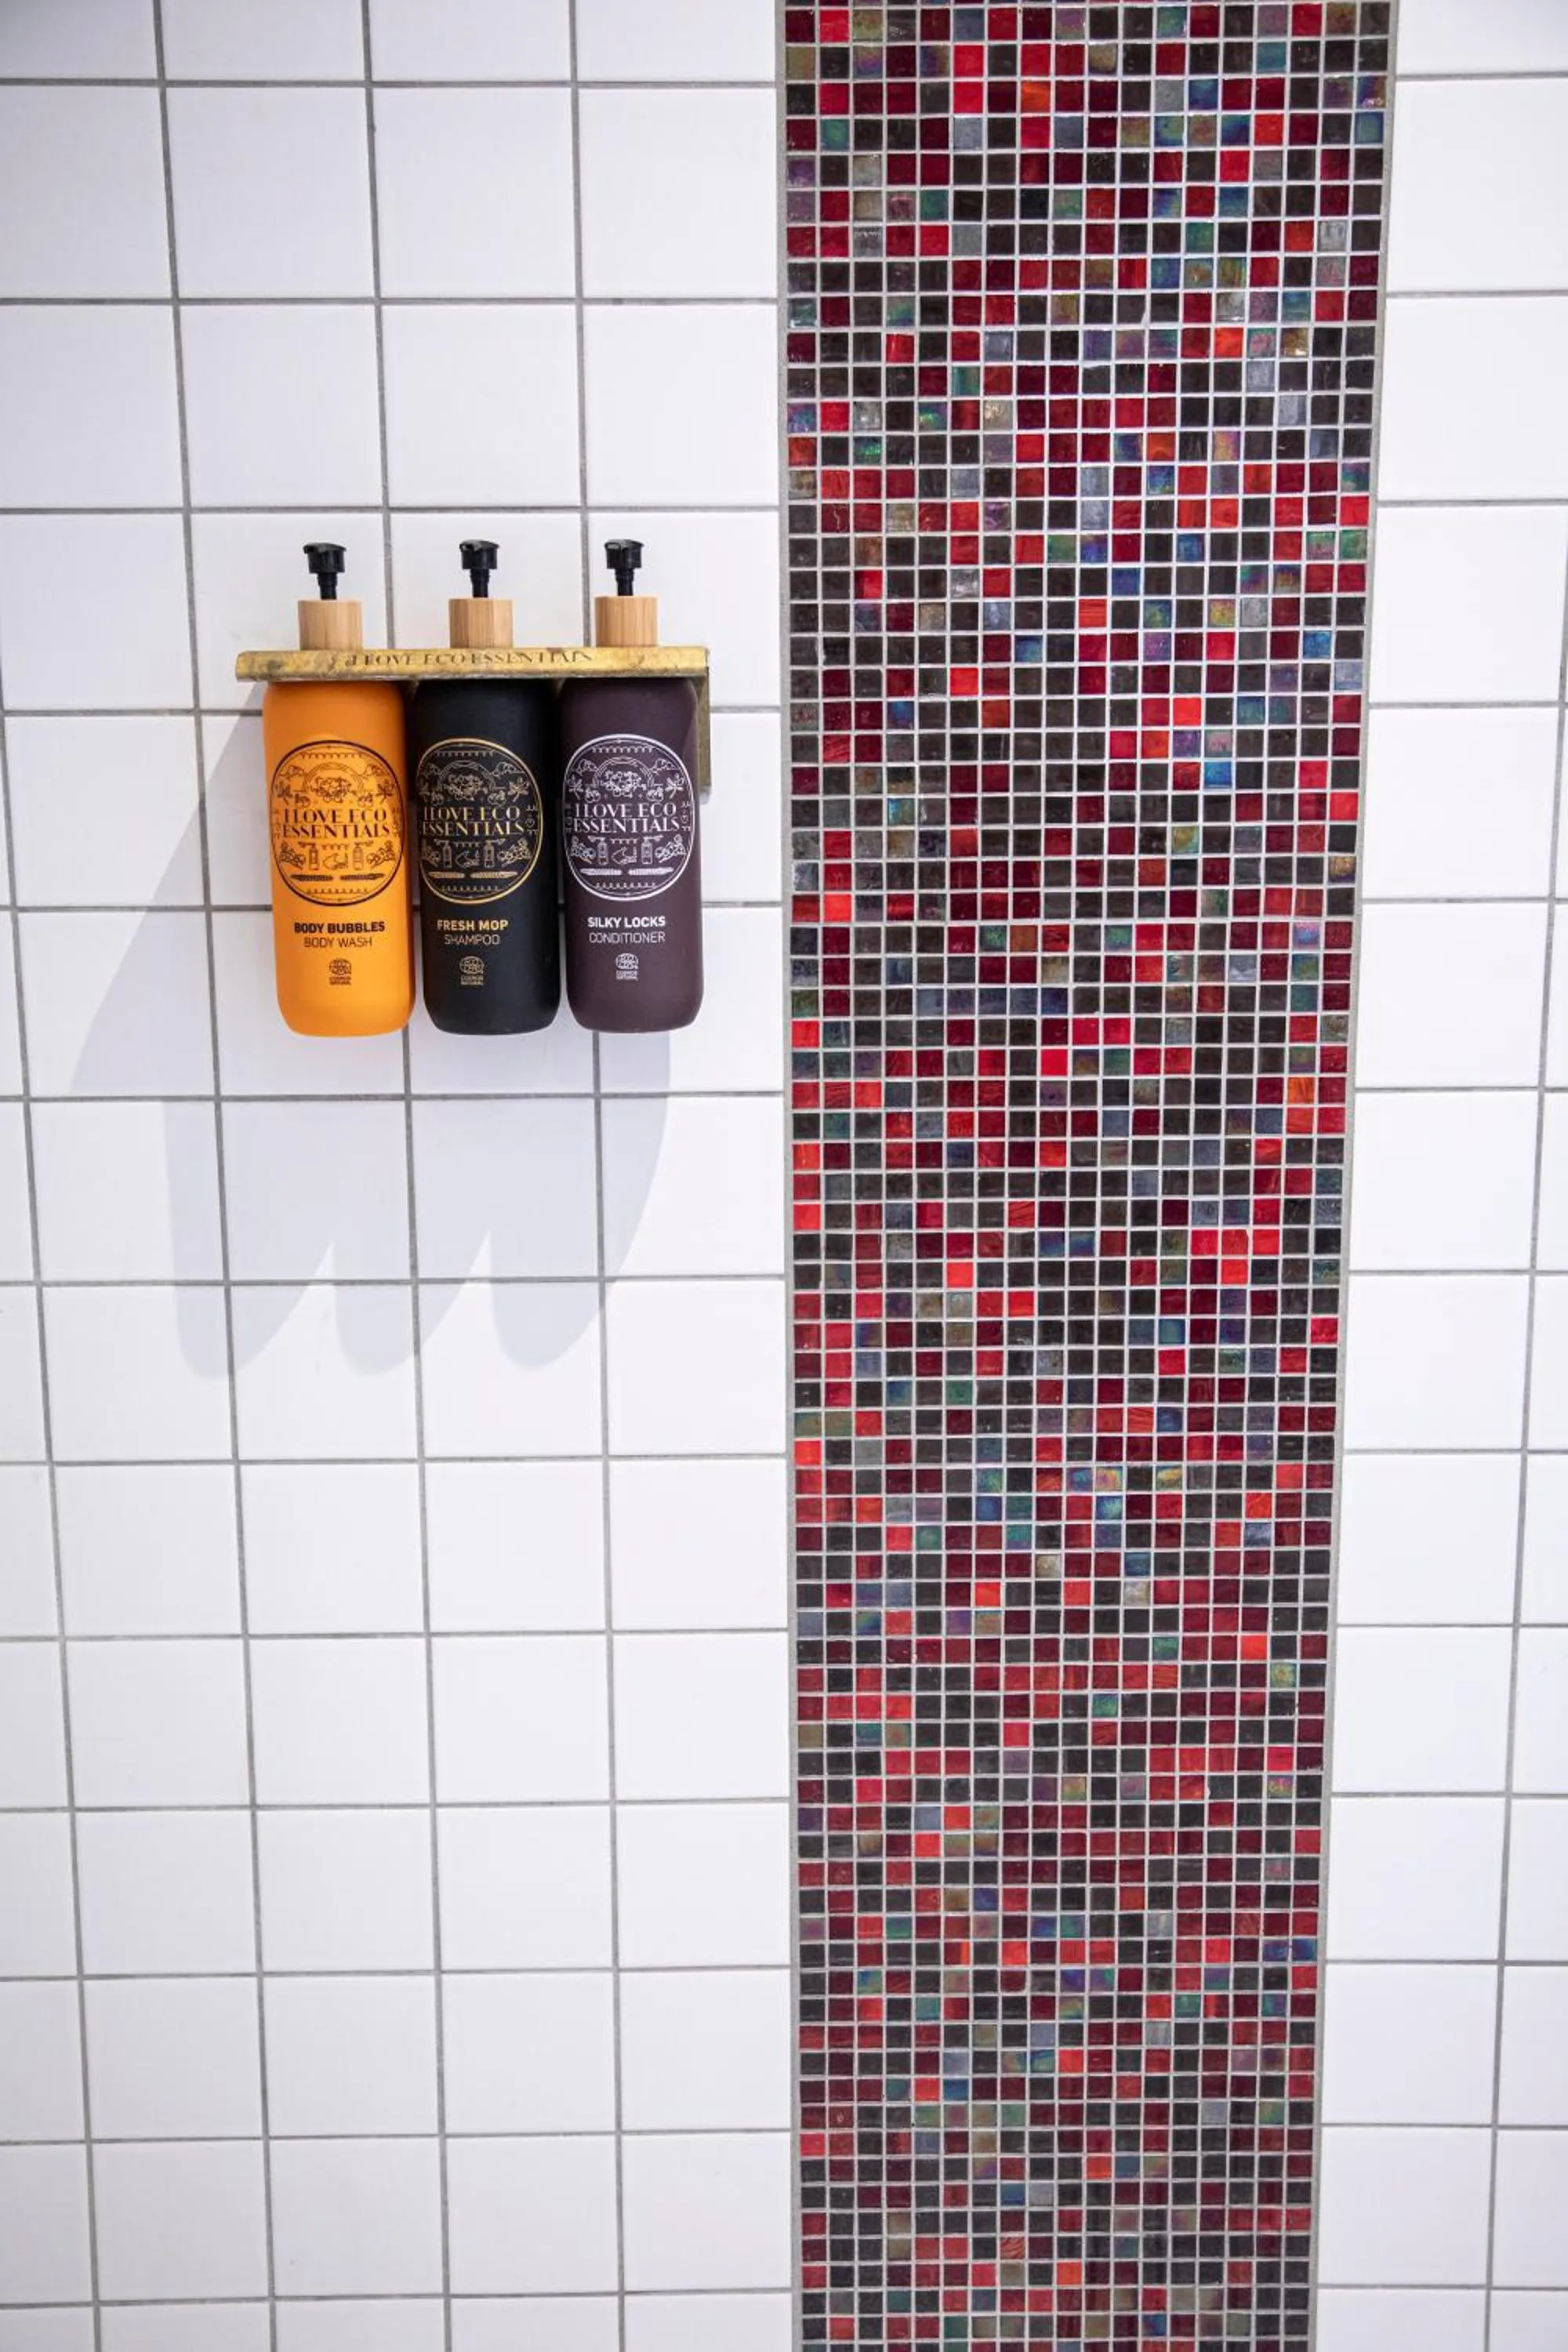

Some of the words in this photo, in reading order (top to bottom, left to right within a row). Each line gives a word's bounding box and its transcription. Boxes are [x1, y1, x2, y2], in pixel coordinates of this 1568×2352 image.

[424, 653, 466, 666] ECO
[293, 808, 343, 823] LOVE
[349, 808, 387, 823] ECO
[430, 806, 474, 821] LOVE
[480, 805, 521, 821] ECO
[583, 803, 633, 818] LOVE
[638, 802, 677, 818] ECO
[282, 824, 390, 839] ESSENTIALS
[423, 821, 524, 837] ESSENTIALS
[573, 817, 680, 833] ESSENTIALS
[294, 922, 324, 934] BODY
[328, 921, 385, 934] BUBBLES
[437, 920, 474, 931] FRESH
[479, 919, 508, 931] MOP
[588, 916, 621, 928] SILKY
[625, 916, 666, 928] LOCKS
[303, 937, 335, 948] BODY
[338, 937, 372, 948] WASH
[445, 934, 499, 946] SHAMPOO
[589, 931, 666, 943] CONDITIONER
